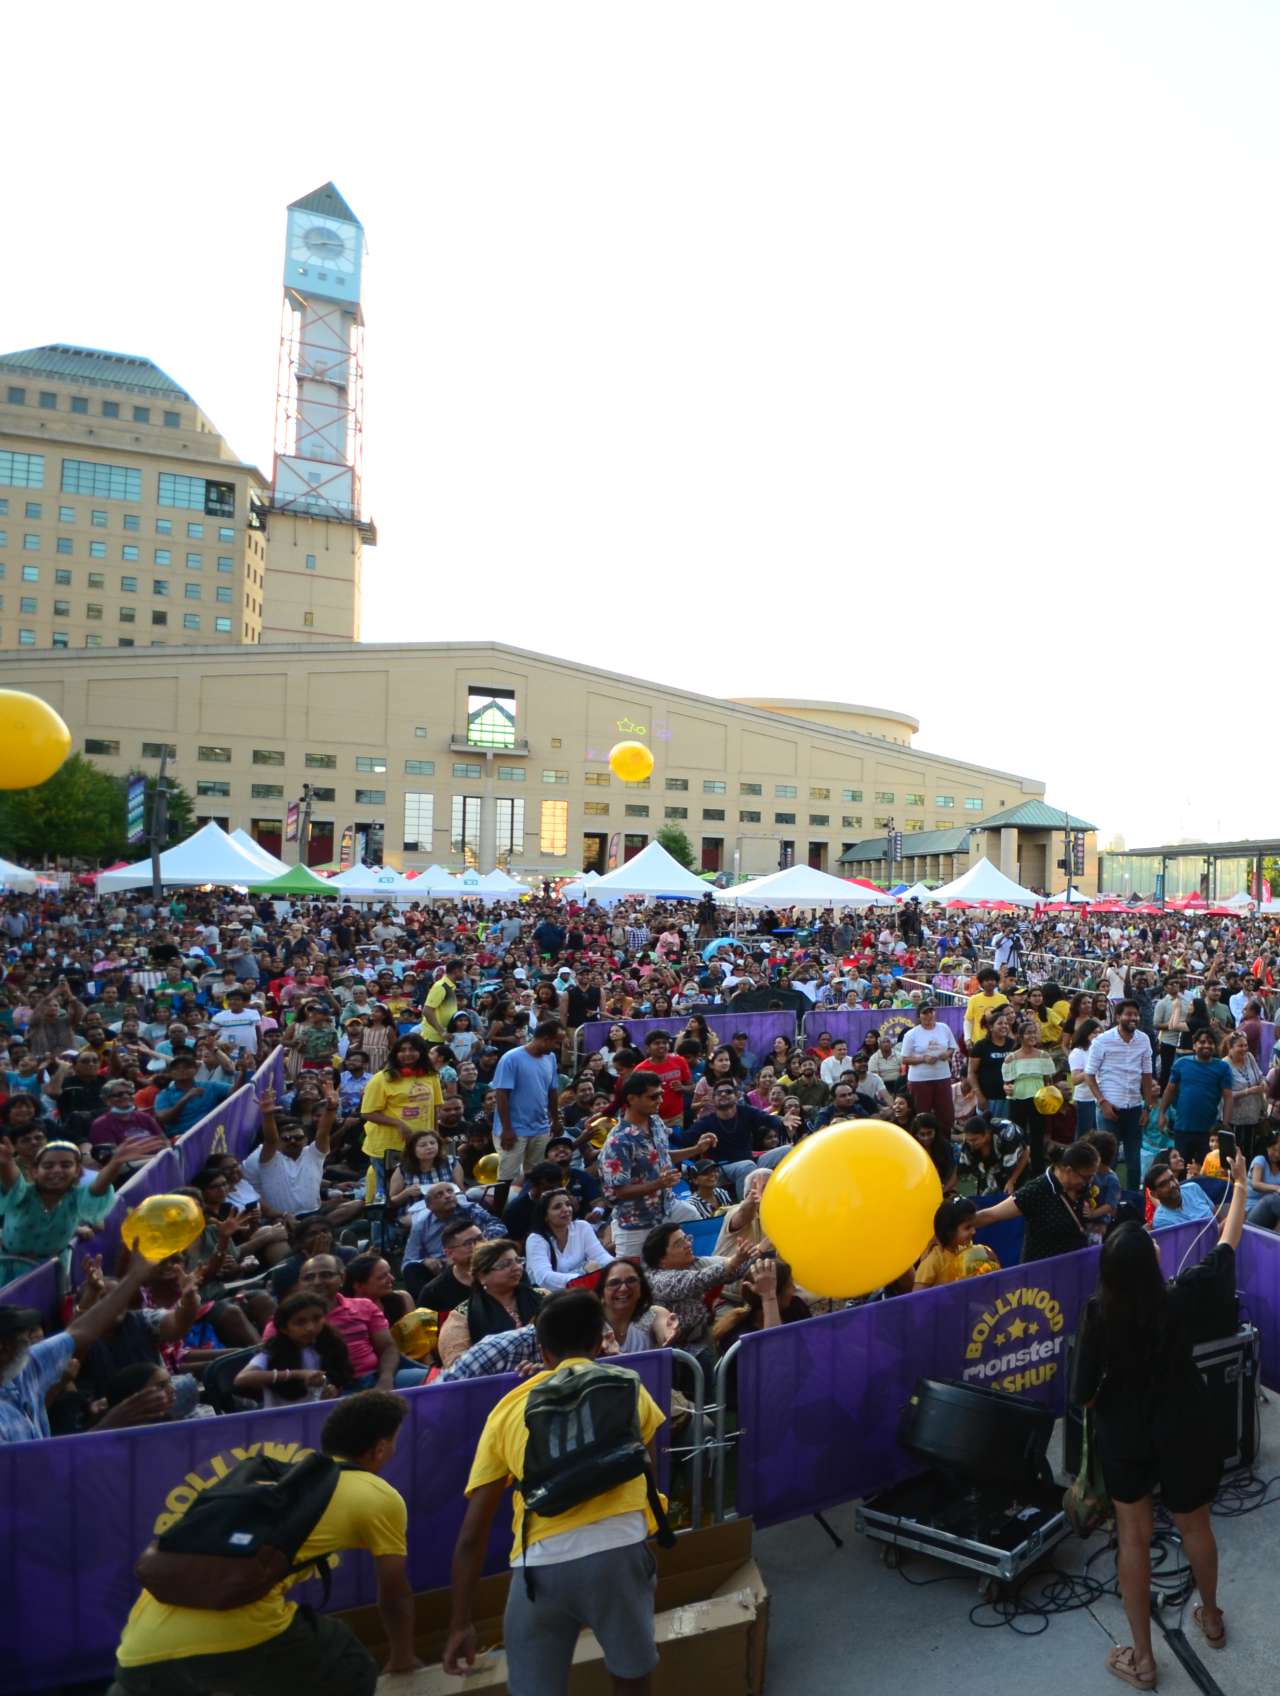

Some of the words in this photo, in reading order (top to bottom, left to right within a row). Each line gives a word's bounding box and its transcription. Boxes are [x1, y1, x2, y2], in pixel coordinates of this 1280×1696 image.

[965, 1287, 1064, 1360] BOLLYWOOD
[962, 1336, 1064, 1382] monster
[991, 1362, 1058, 1393] SHUP
